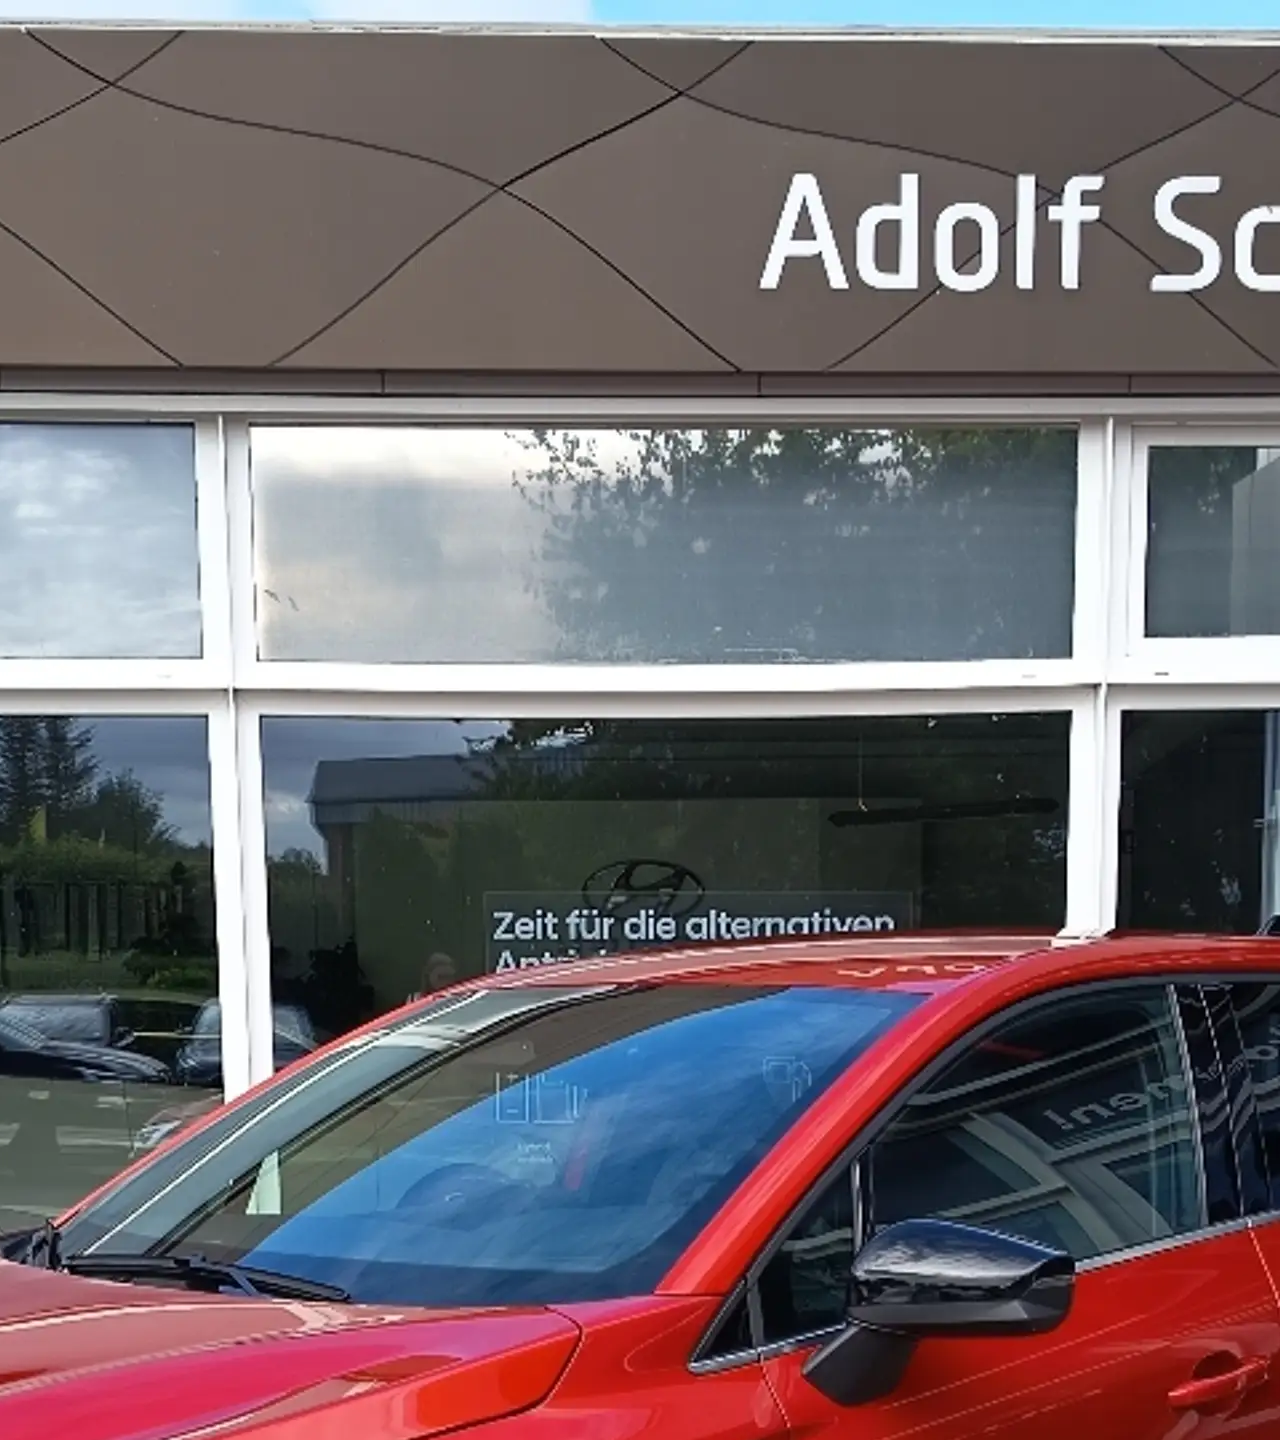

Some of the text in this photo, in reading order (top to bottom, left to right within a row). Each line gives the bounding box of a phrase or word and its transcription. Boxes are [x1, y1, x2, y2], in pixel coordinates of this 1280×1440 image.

[760, 173, 1104, 292] Adolf
[493, 908, 896, 941] Zeit für die alternativen
